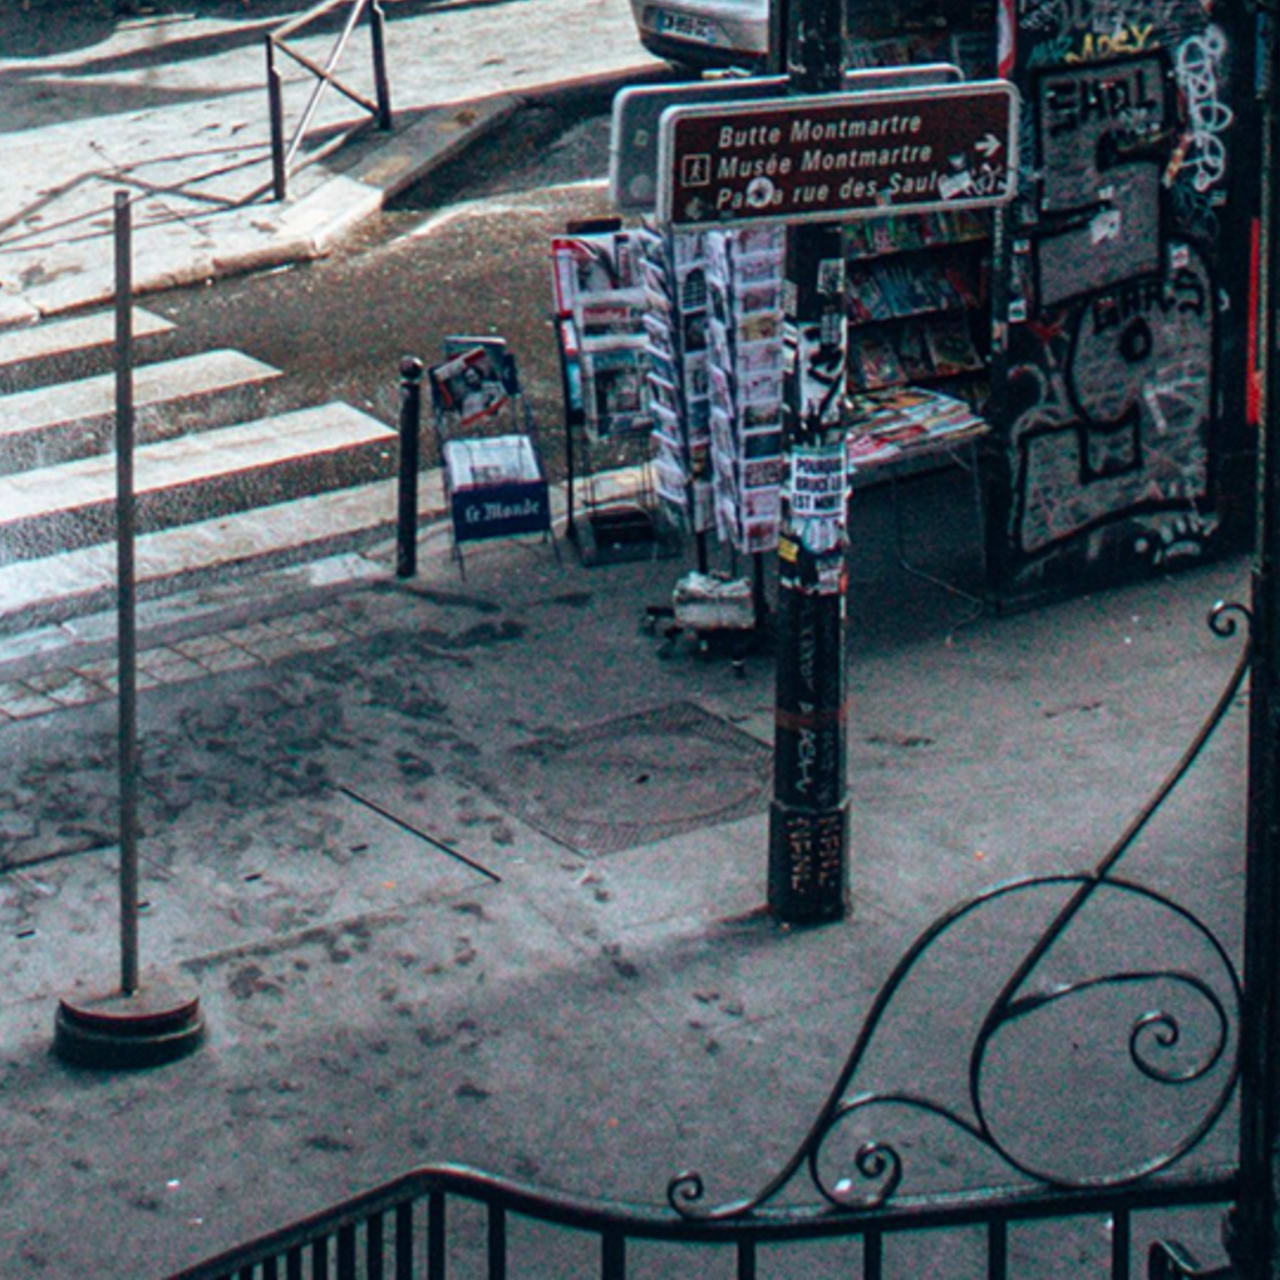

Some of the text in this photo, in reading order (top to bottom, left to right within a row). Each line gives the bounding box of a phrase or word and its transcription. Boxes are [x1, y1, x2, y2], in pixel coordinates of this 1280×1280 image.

[719, 115, 923, 149] Butte Montmartre
[718, 143, 932, 180] Musée Montmartre
[792, 181, 827, 204] rue
[838, 174, 878, 199] des
[483, 497, 540, 521] Monde
